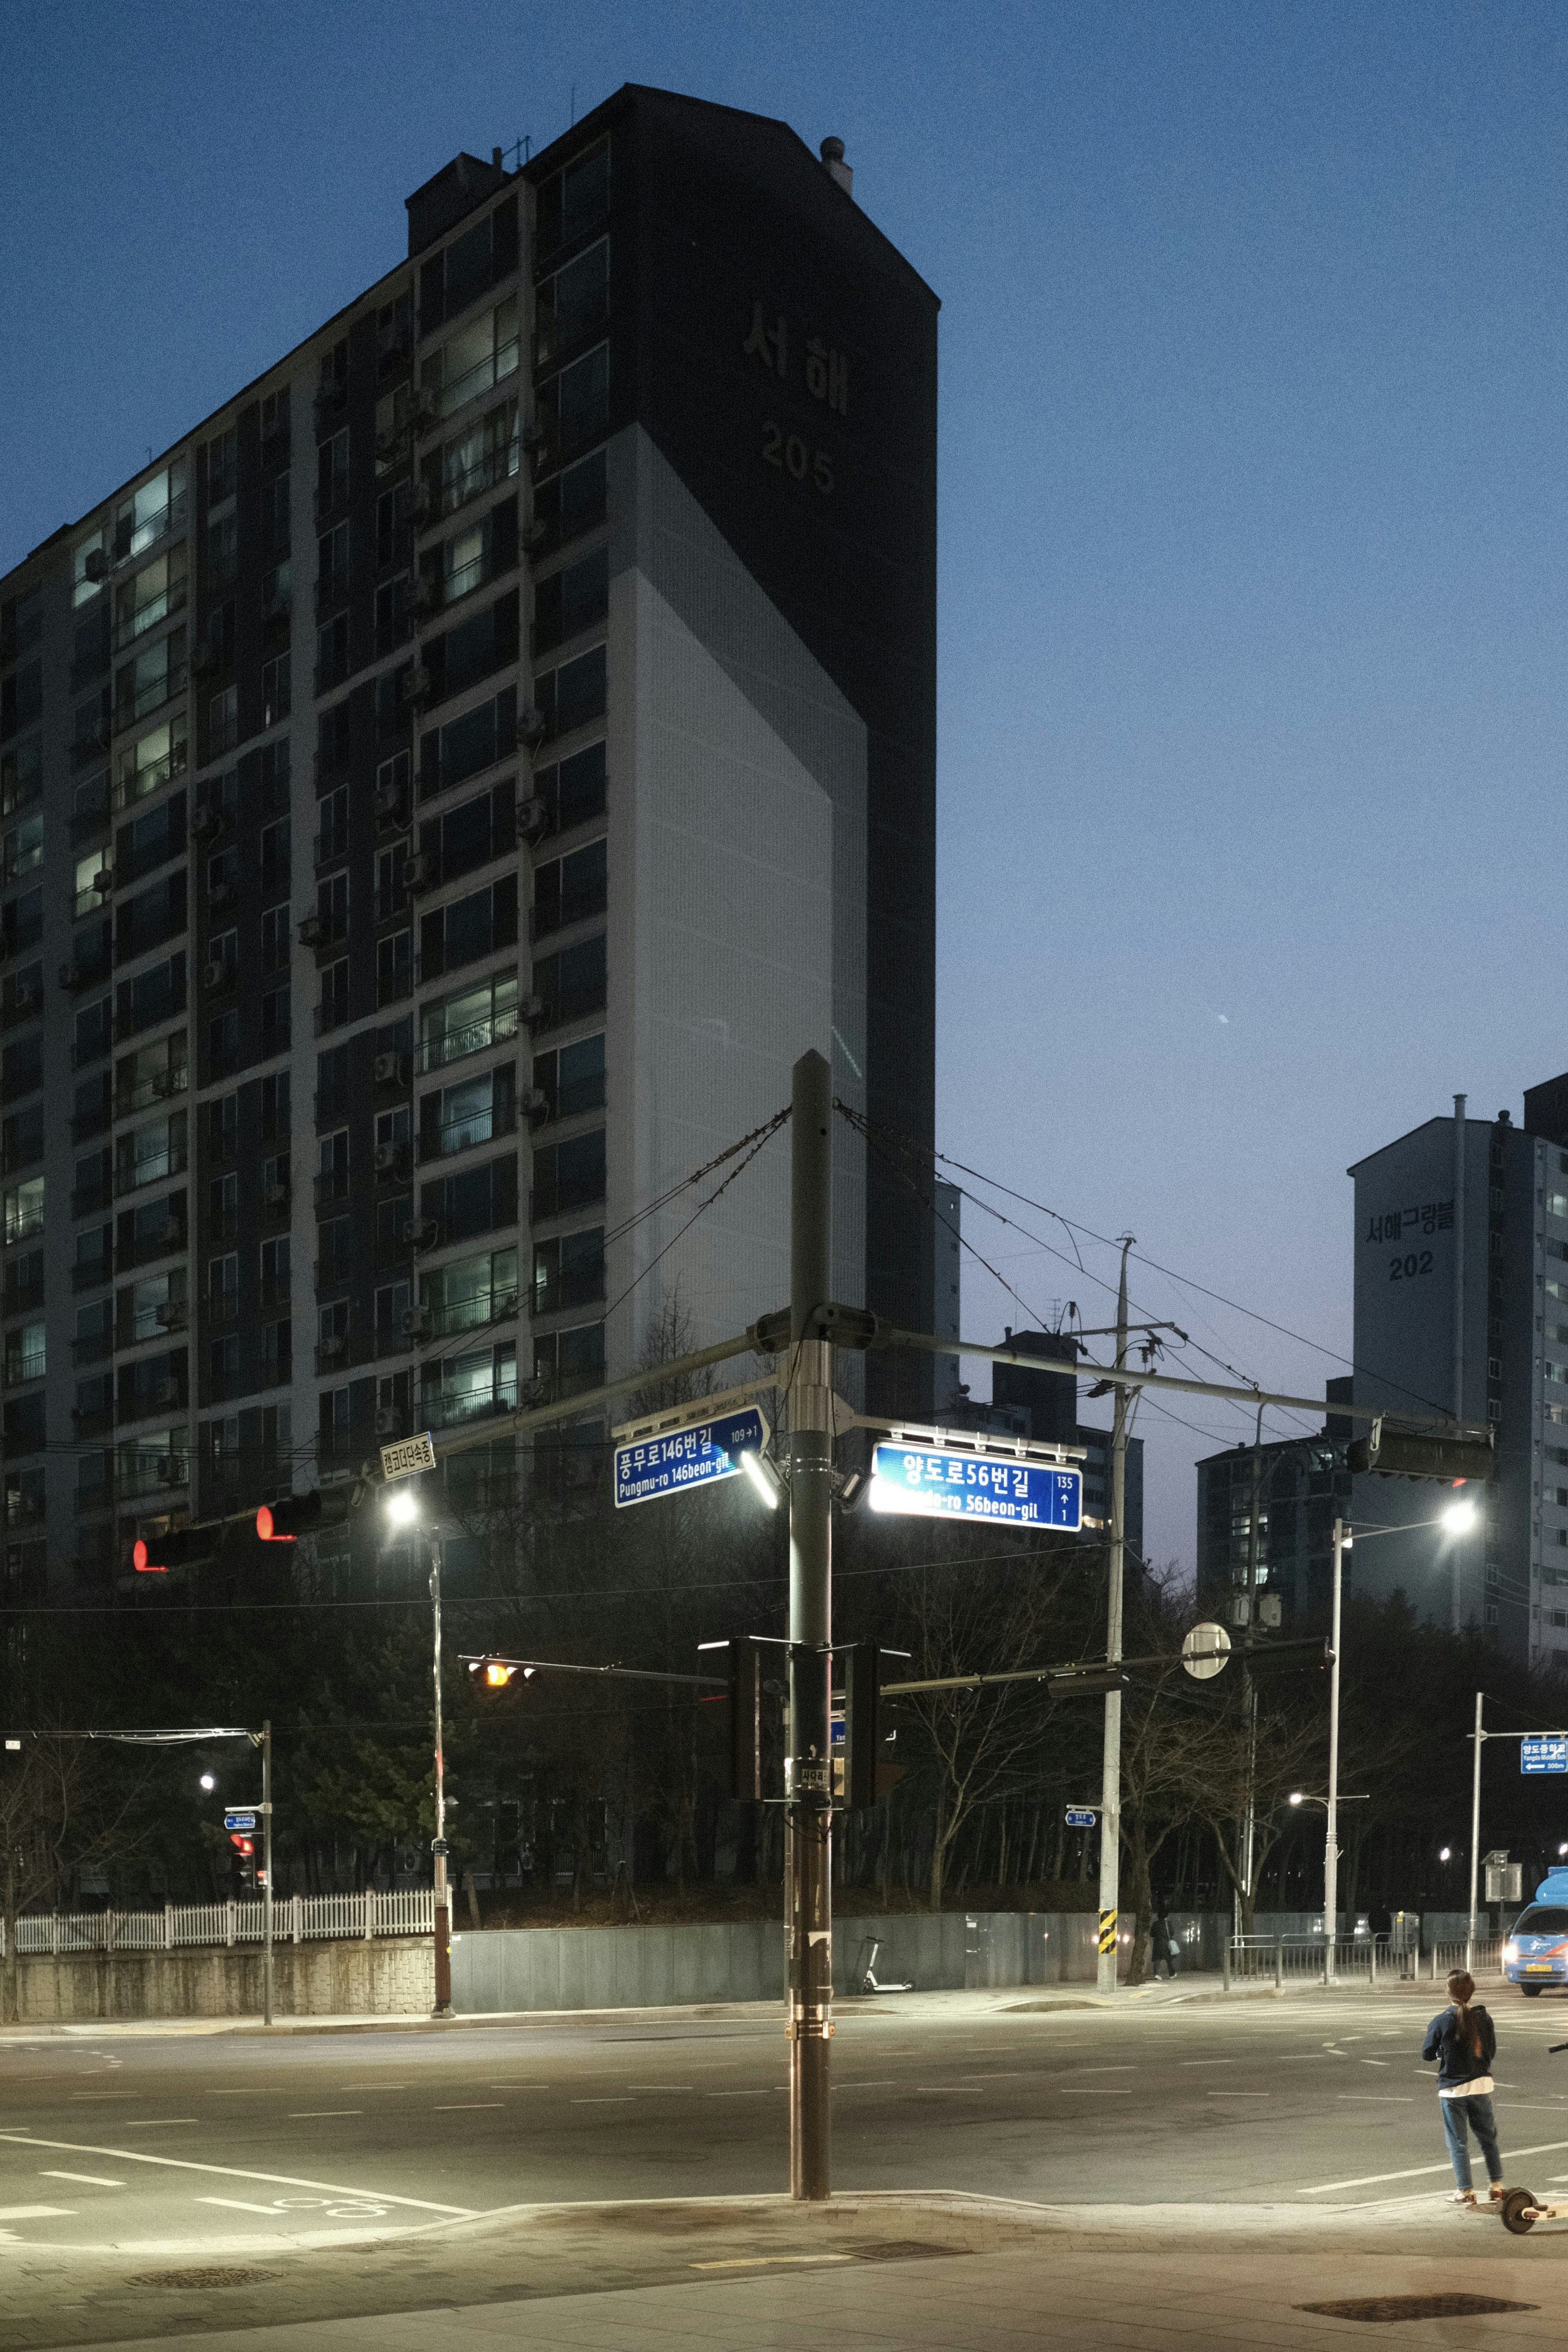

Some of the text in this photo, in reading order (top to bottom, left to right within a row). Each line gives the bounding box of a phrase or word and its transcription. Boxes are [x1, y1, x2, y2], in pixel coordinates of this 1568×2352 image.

[762, 420, 834, 495] 205
[1389, 1250, 1433, 1282] 202
[731, 1429, 745, 1443] 109
[384, 1440, 430, 1474] 캠코더단속중
[619, 1427, 712, 1480] 풍무로146번길
[619, 1451, 729, 1498] Pungmu-ro 146beon-gil
[903, 1454, 1029, 1498] 양도로56번길
[1057, 1476, 1073, 1489] 135
[966, 1494, 1038, 1521] 56beon-gil
[1062, 1510, 1067, 1521] 1
[1523, 1744, 1565, 1754] 양도중학교
[803, 1770, 823, 1782] 사다리
